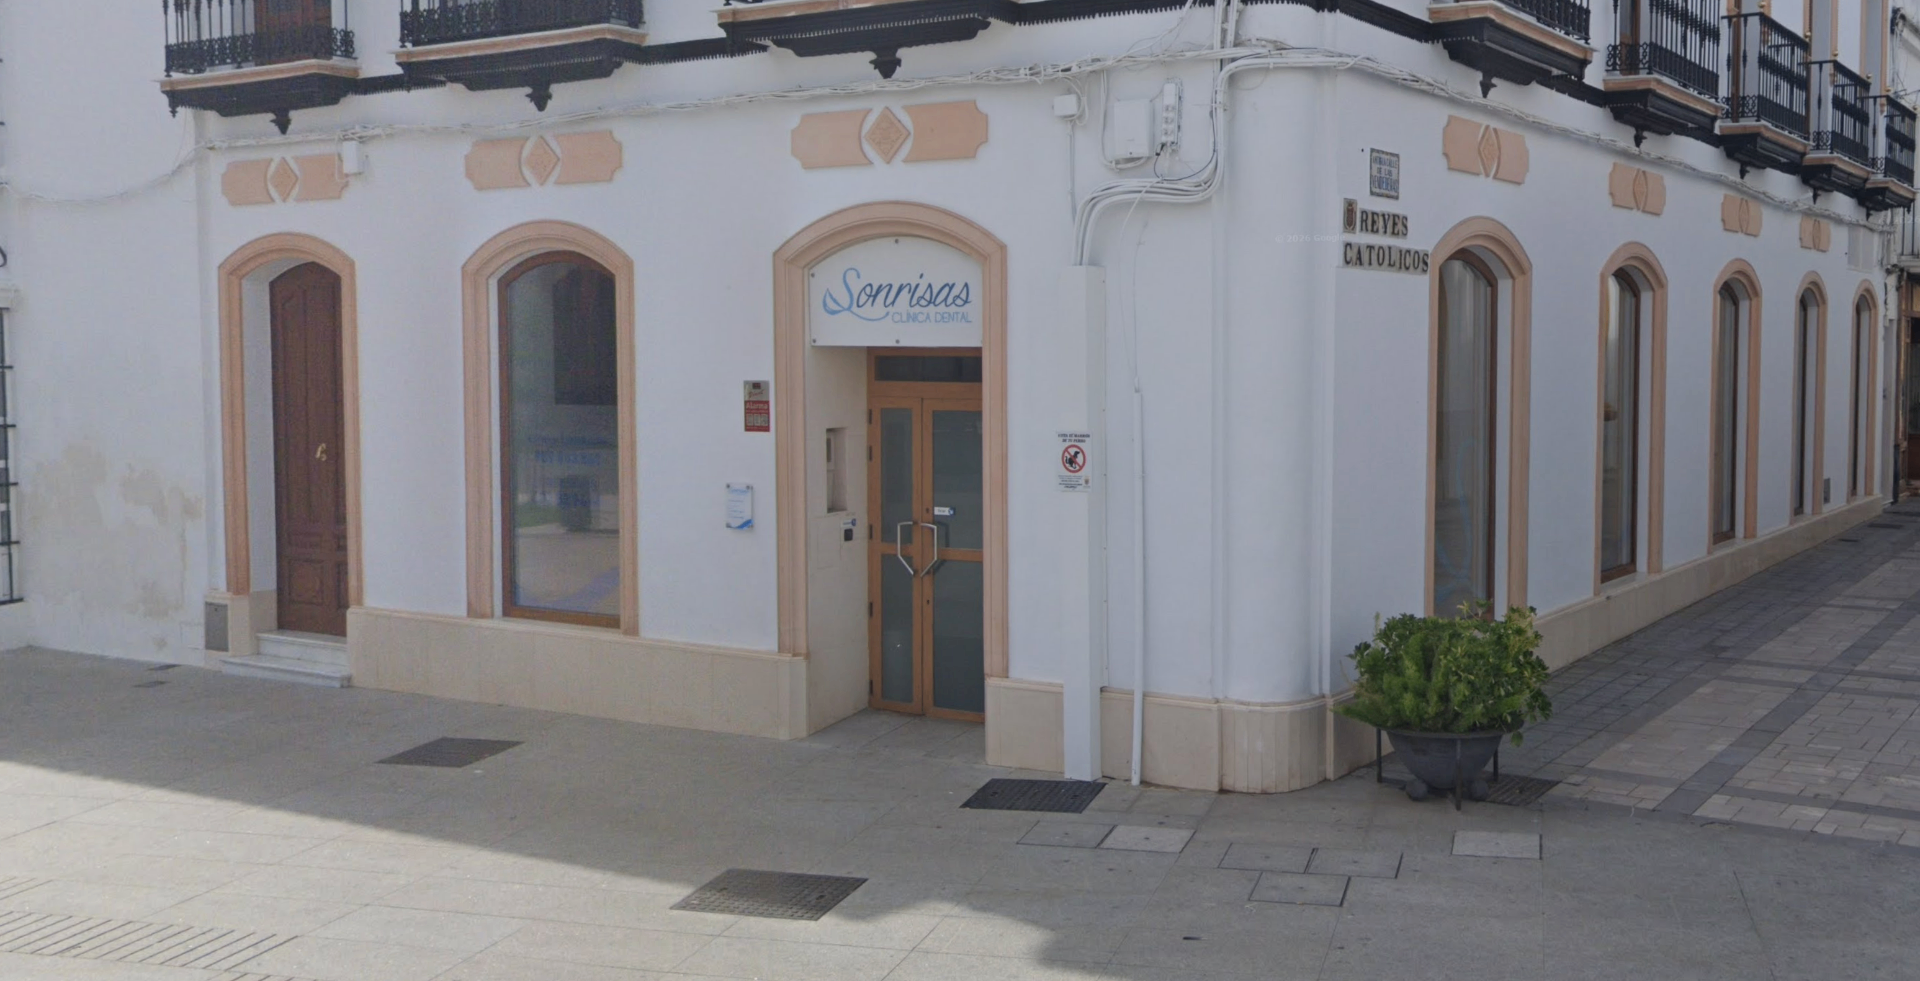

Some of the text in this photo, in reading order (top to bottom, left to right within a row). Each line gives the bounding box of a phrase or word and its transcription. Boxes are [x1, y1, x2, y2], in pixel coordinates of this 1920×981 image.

[1377, 167, 1392, 177] DE LAS
[1360, 210, 1408, 236] REYES
[1344, 243, 1429, 272] CATOLICOS
[822, 267, 972, 321] Sonrisas
[891, 309, 972, 323] CLÍNICA DENTAL
[746, 401, 768, 409] Alarma
